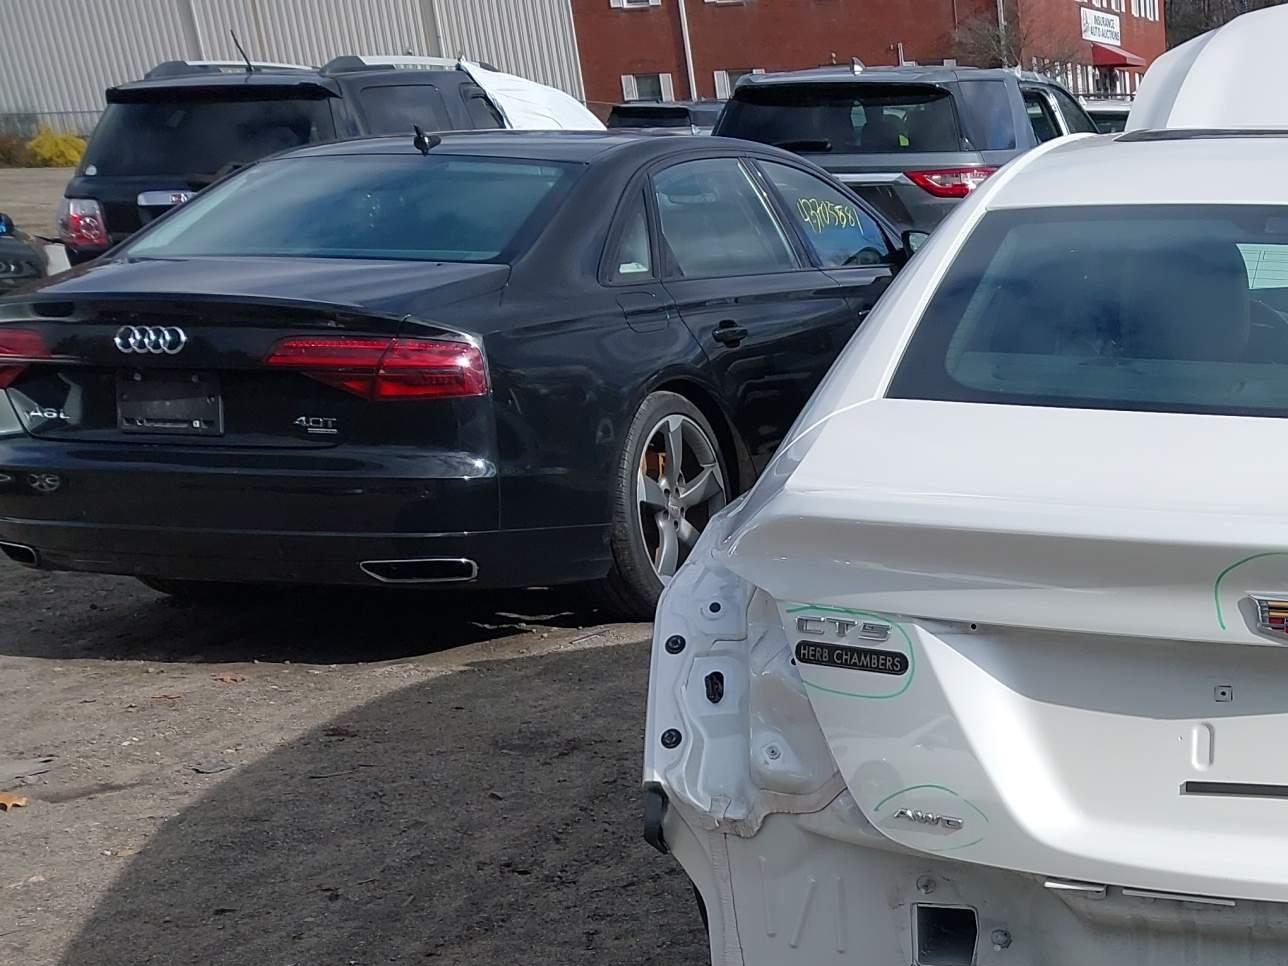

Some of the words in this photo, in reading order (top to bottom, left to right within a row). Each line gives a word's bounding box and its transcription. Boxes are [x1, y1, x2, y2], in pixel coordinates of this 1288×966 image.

[795, 615, 892, 641] CTS
[800, 645, 829, 661] HERB
[833, 650, 901, 671] CHAMBERS
[893, 808, 963, 830] AWD
